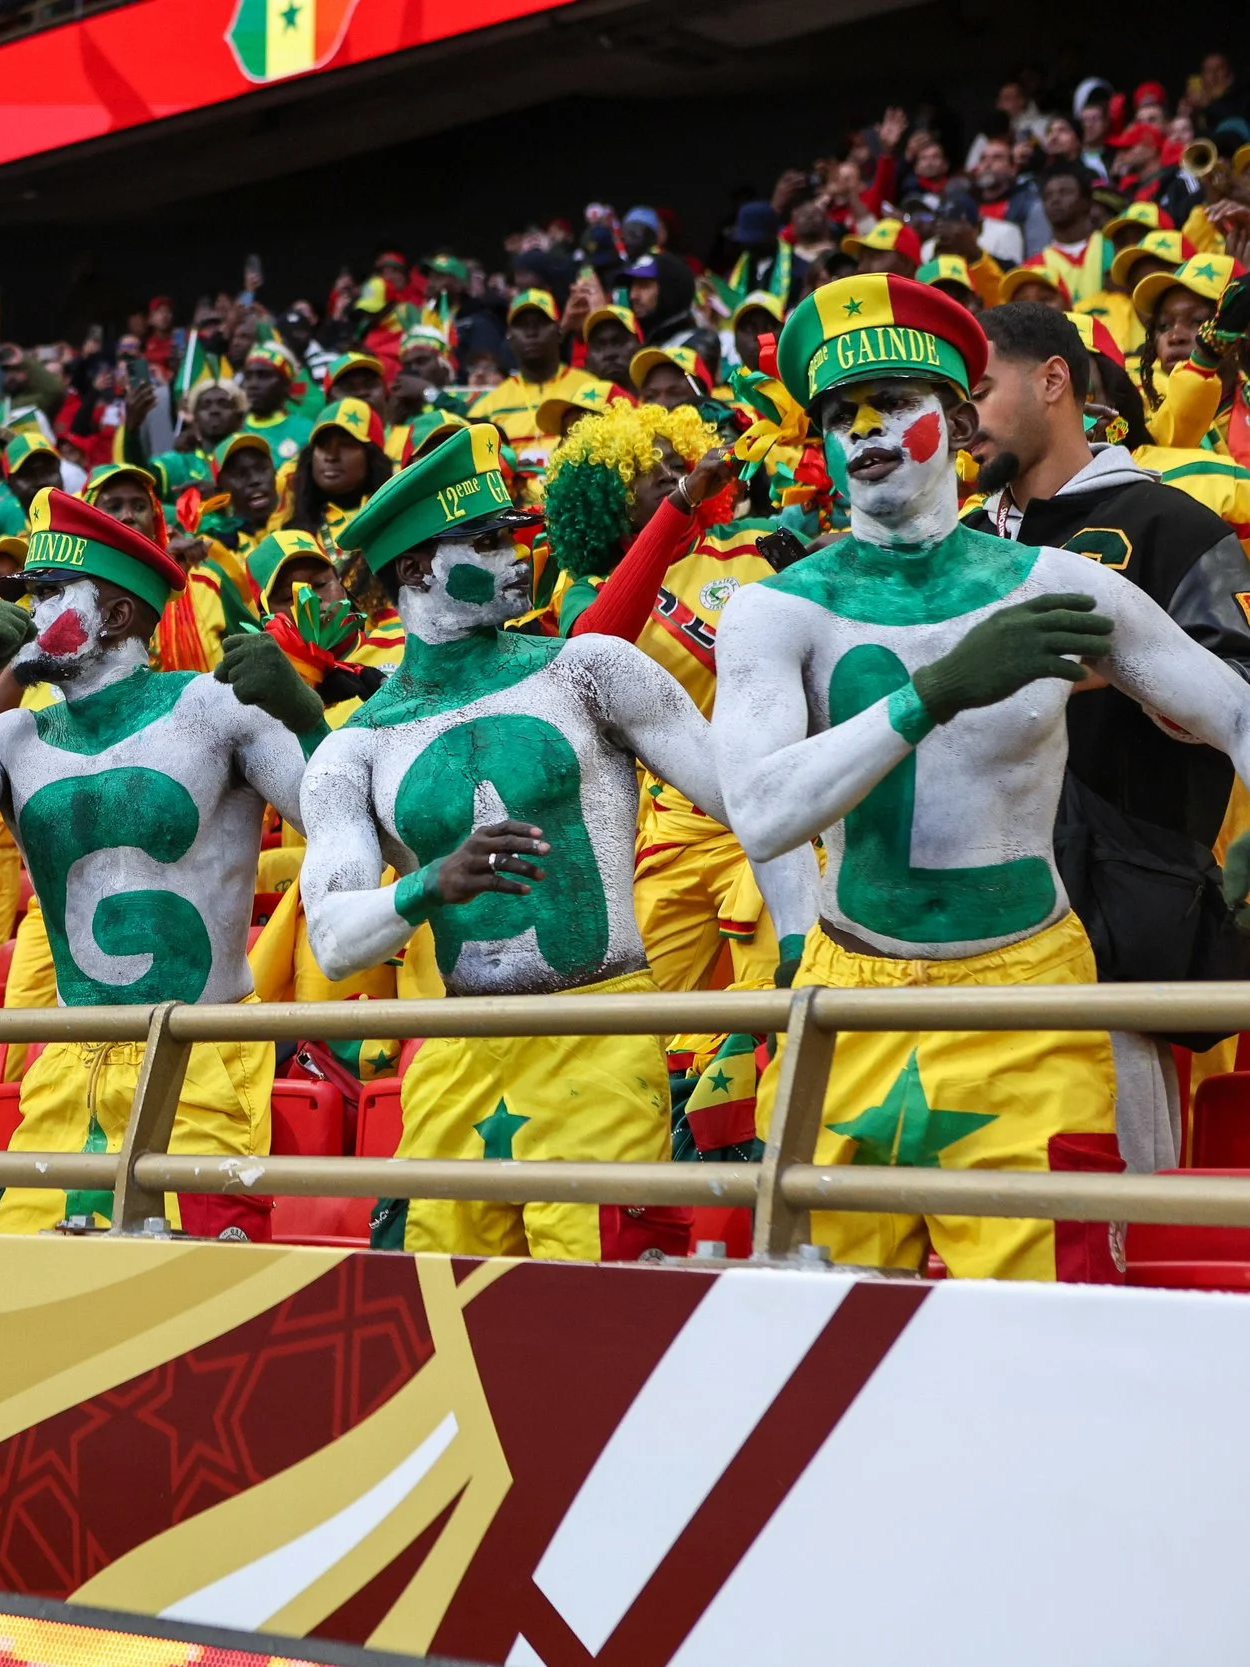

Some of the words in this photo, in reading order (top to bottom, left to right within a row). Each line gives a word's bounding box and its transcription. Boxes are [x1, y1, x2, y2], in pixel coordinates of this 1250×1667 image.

[837, 327, 940, 369] GAINDE
[26, 533, 88, 566] AINDE
[19, 766, 213, 1007] G
[394, 713, 609, 976] A
[828, 643, 1057, 943] L
